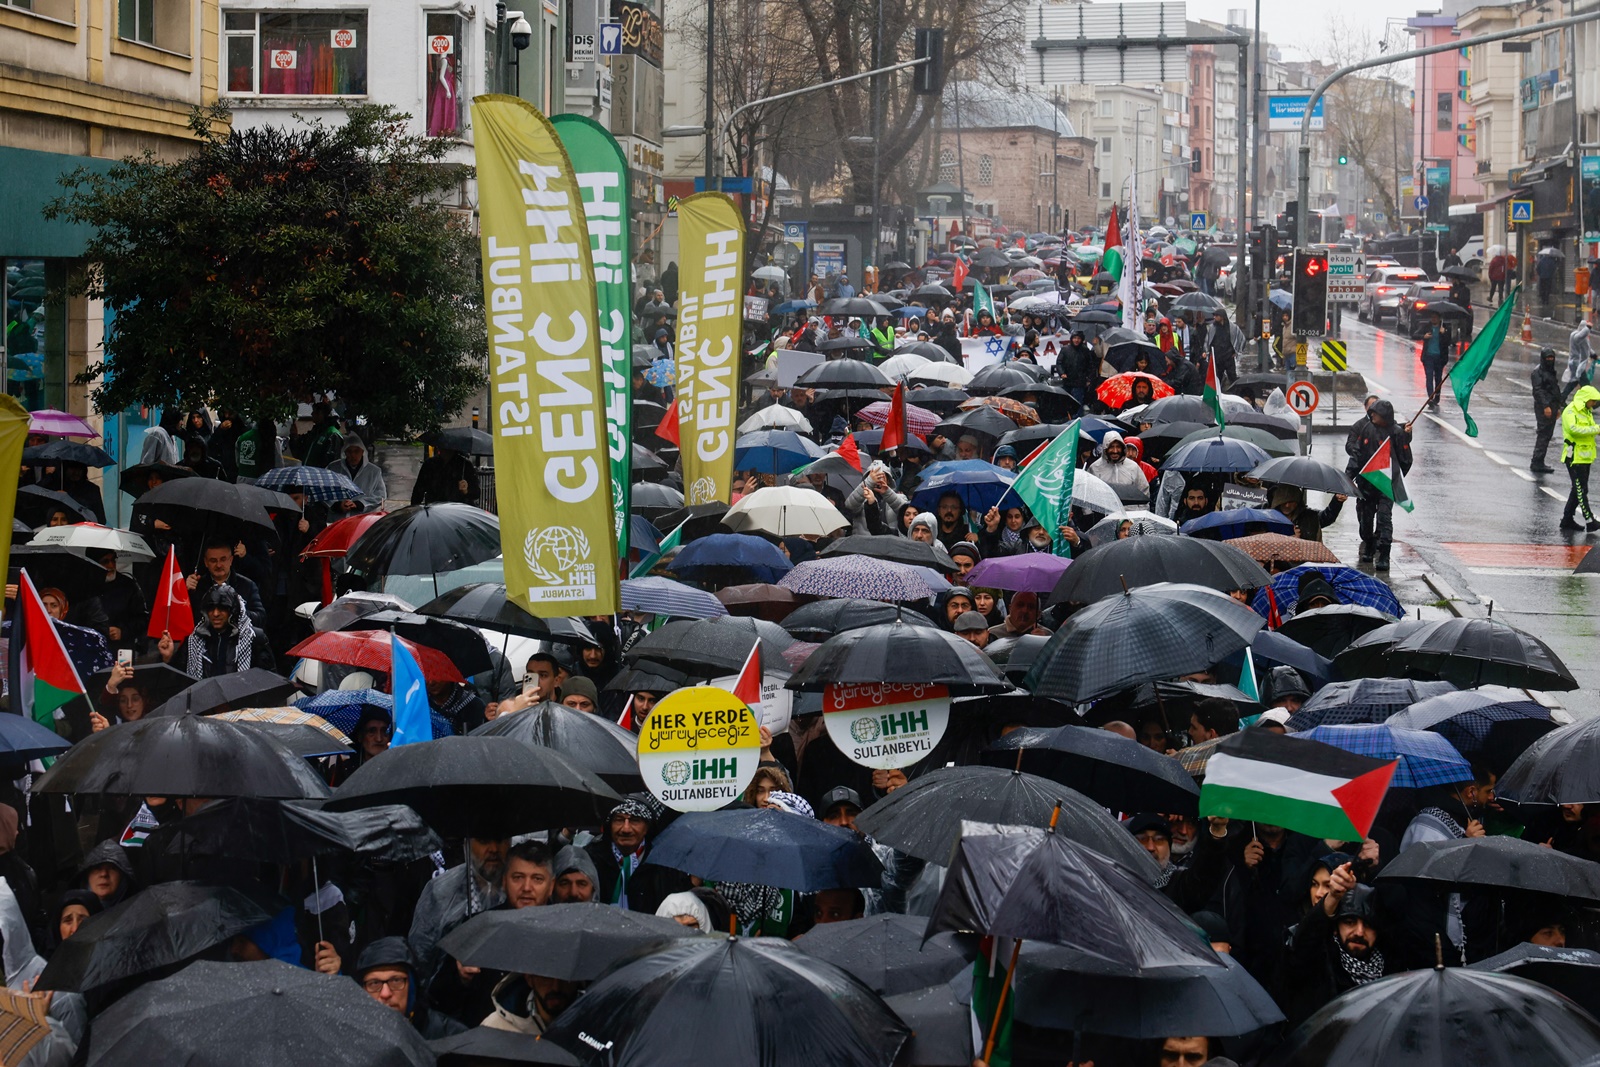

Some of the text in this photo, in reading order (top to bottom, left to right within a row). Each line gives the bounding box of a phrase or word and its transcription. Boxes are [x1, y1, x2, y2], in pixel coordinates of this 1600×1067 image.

[337, 33, 351, 41] 2000
[433, 39, 448, 47] 2000
[276, 53, 291, 61] 2000
[1330, 254, 1354, 263] ekapı
[1328, 265, 1353, 274] eyolu
[651, 713, 686, 730] HER
[692, 708, 748, 726] YERDE
[649, 724, 750, 750] yürüyeceğiz
